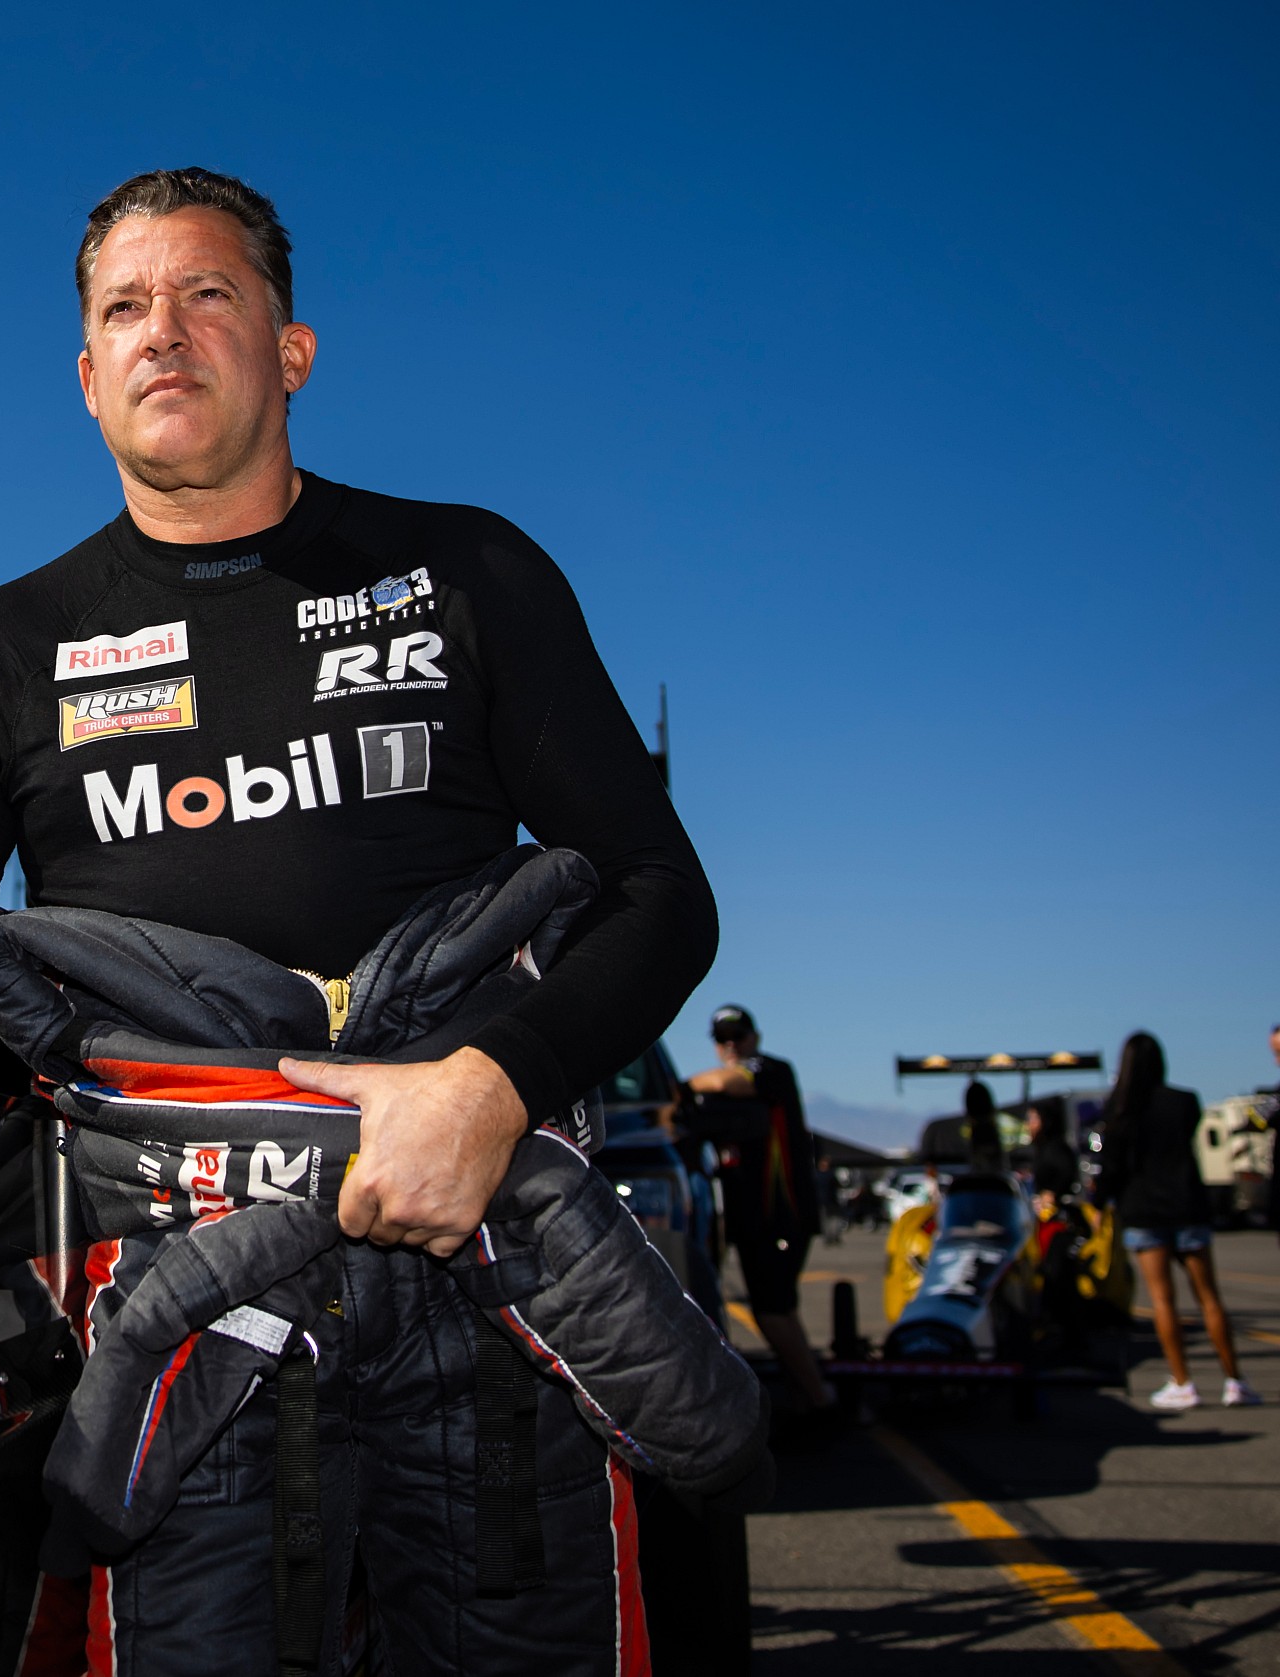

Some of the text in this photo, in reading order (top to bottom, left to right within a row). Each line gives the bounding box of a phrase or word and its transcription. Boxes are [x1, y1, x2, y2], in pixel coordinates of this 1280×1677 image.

[184, 553, 263, 580] SIMPSON
[297, 587, 372, 629] CODE
[410, 567, 433, 597] 3
[299, 600, 435, 642] ASSOCIATES
[69, 632, 175, 669] Rinnai
[315, 631, 448, 692] RR
[74, 684, 180, 719] RUSH
[313, 681, 448, 703] RAYCE RUDEEN FOUNDATION
[84, 711, 170, 733] TRUCK CENTERS
[83, 733, 341, 843] Mobil
[383, 731, 405, 788] 1
